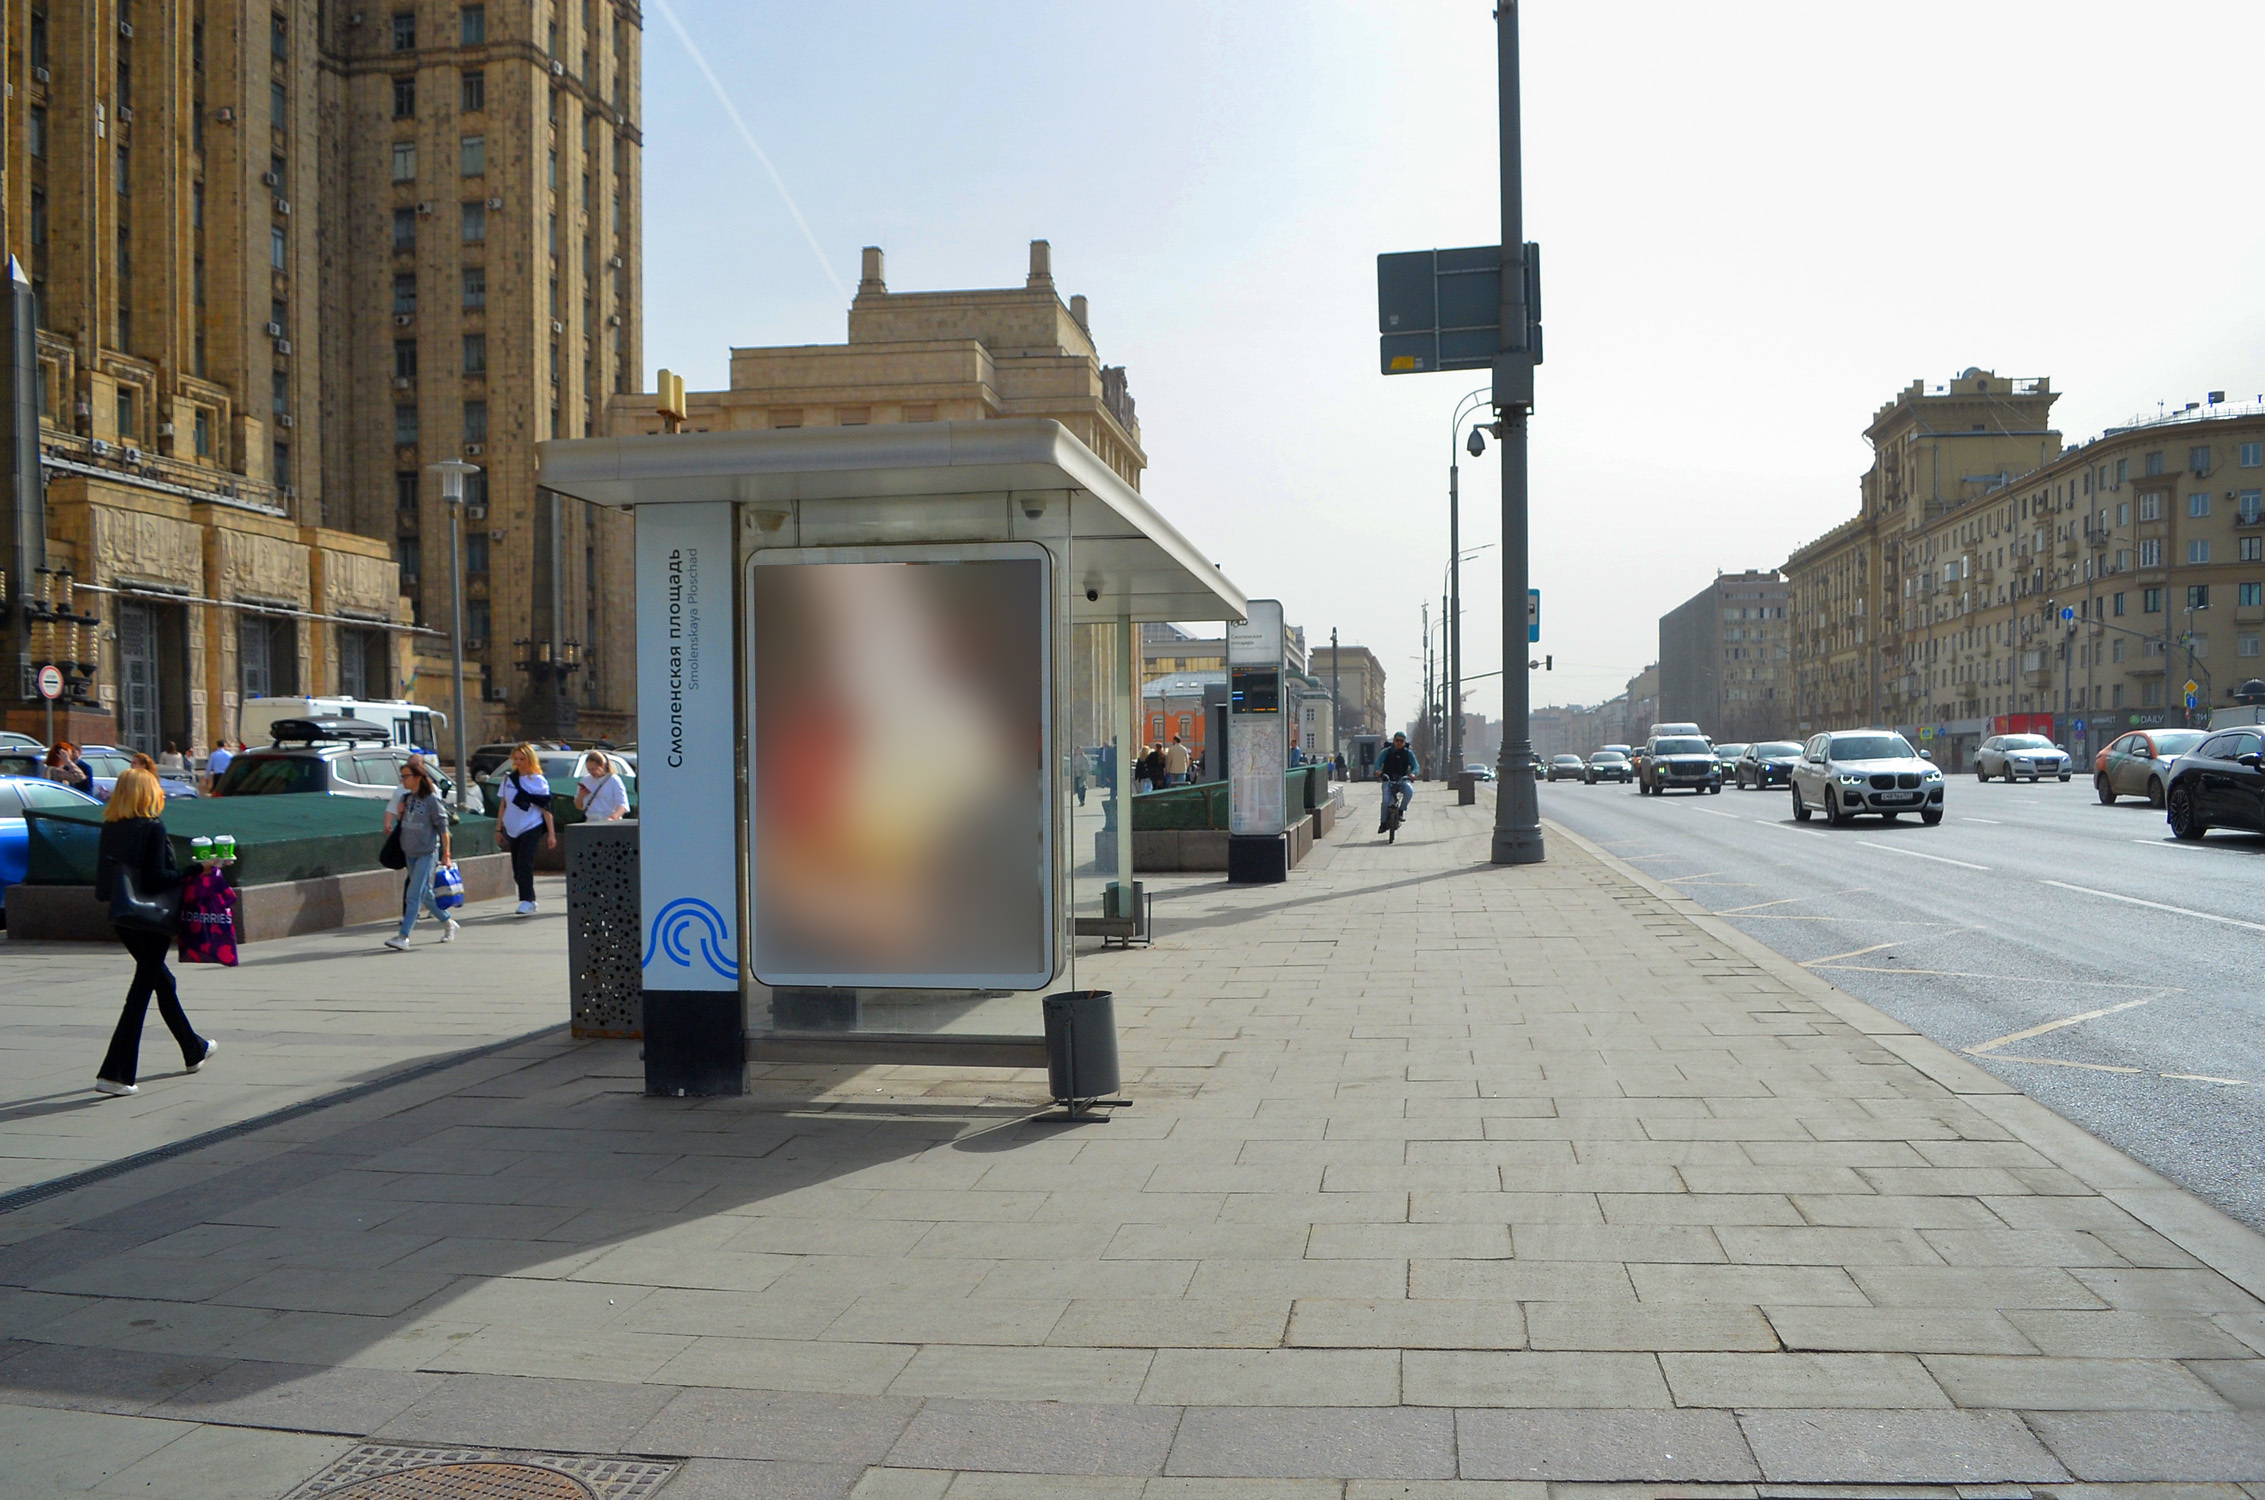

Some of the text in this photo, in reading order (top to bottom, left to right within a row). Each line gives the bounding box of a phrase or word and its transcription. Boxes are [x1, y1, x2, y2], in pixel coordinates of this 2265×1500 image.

[686, 548, 700, 690] Smolenskaya Ploschad
[668, 549, 683, 768] Смоленская площадь
[2140, 715, 2164, 724] DAILY
[182, 911, 232, 924] LDBERRIES
